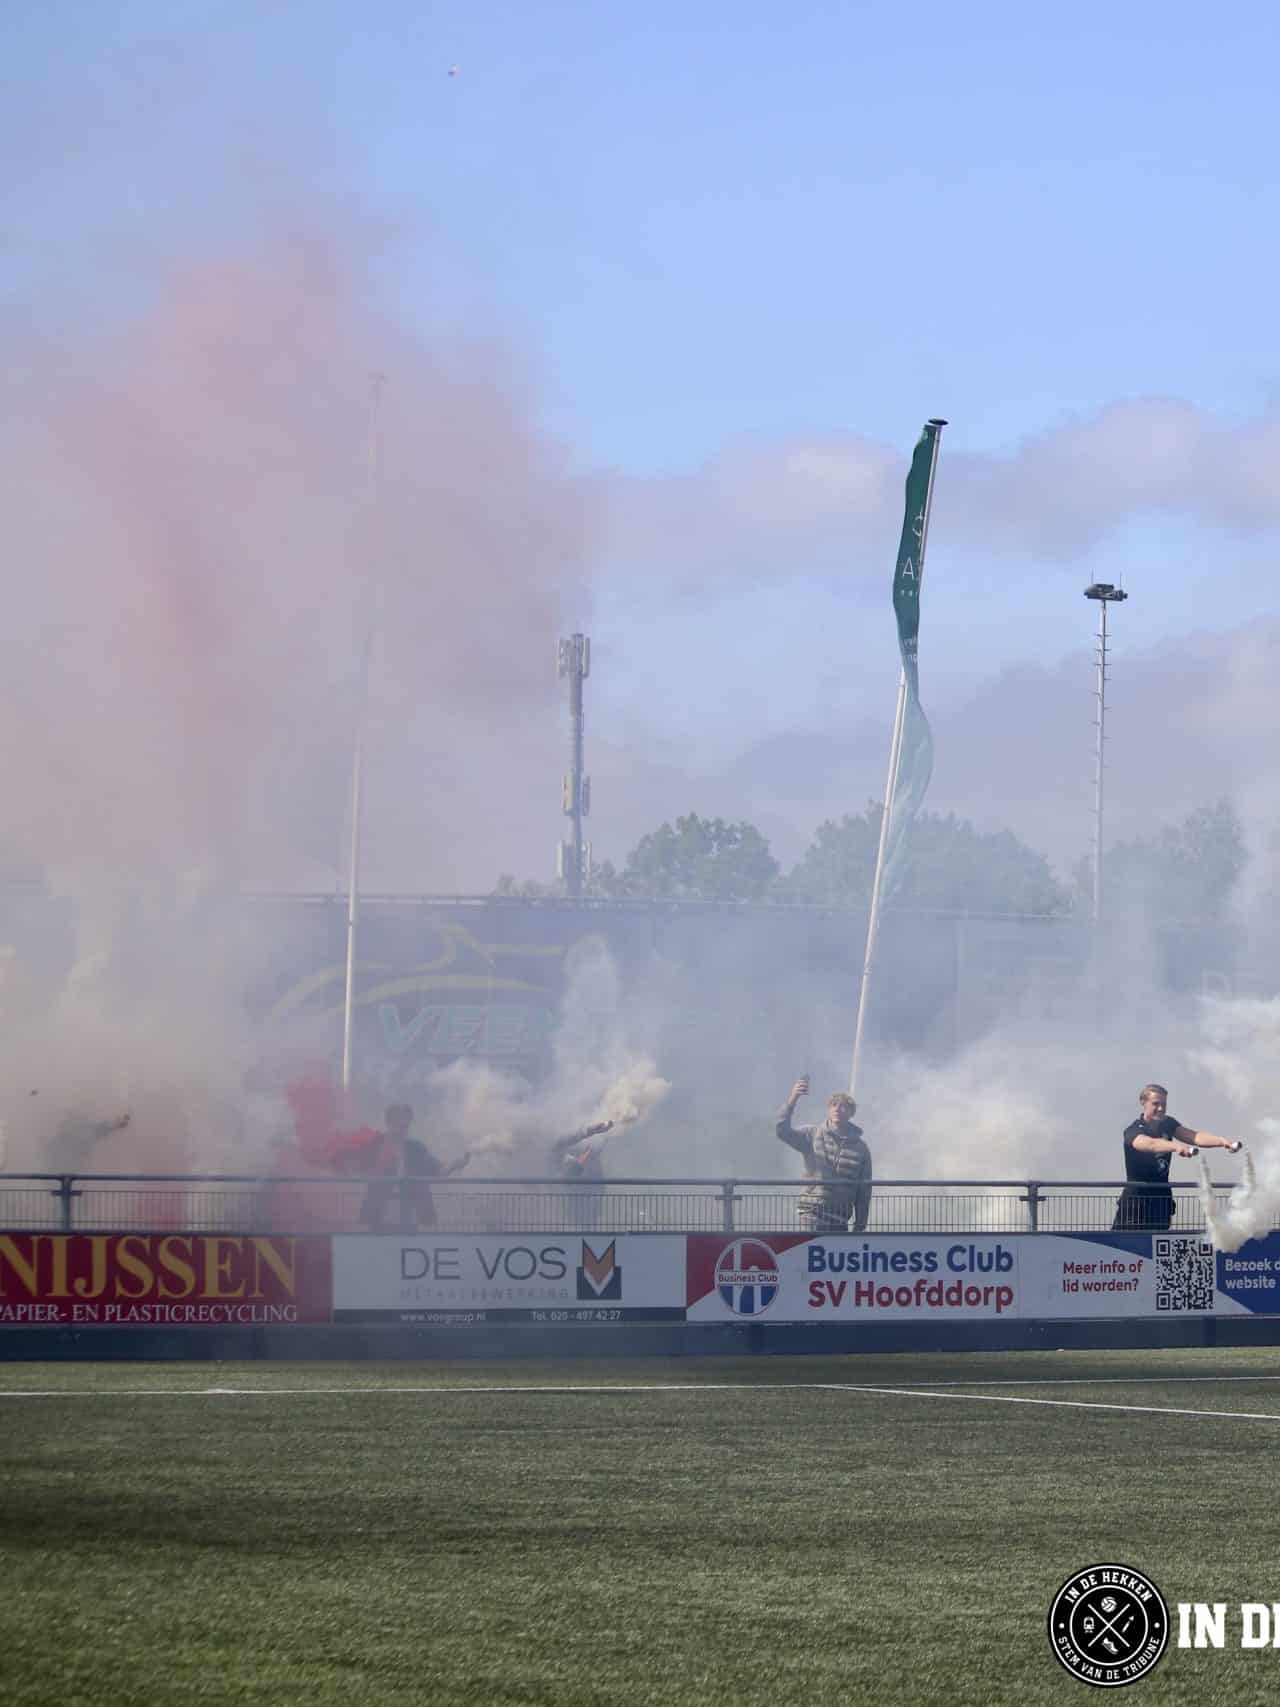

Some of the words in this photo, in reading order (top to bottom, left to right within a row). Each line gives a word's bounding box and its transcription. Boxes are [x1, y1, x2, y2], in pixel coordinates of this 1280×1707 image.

[0, 1234, 302, 1298] NIJSSEN
[400, 1246, 461, 1281] DE
[475, 1246, 568, 1281] VOS
[807, 1243, 939, 1273] Business
[946, 1244, 1014, 1273] Club
[1224, 1258, 1271, 1272] Bezoek
[1062, 1261, 1097, 1275] Meer
[1100, 1260, 1126, 1274] info
[1128, 1259, 1144, 1273] of
[719, 1273, 756, 1282] Business
[757, 1273, 778, 1282] Club
[1062, 1278, 1079, 1293] lid
[1082, 1278, 1139, 1293] worden?
[1224, 1275, 1277, 1289] website
[807, 1280, 848, 1307] SV
[854, 1278, 1014, 1314] Hoofddorp
[0, 1303, 68, 1321] APIER-
[72, 1303, 99, 1321] EN
[104, 1303, 298, 1322] PLASTICRECYCLING
